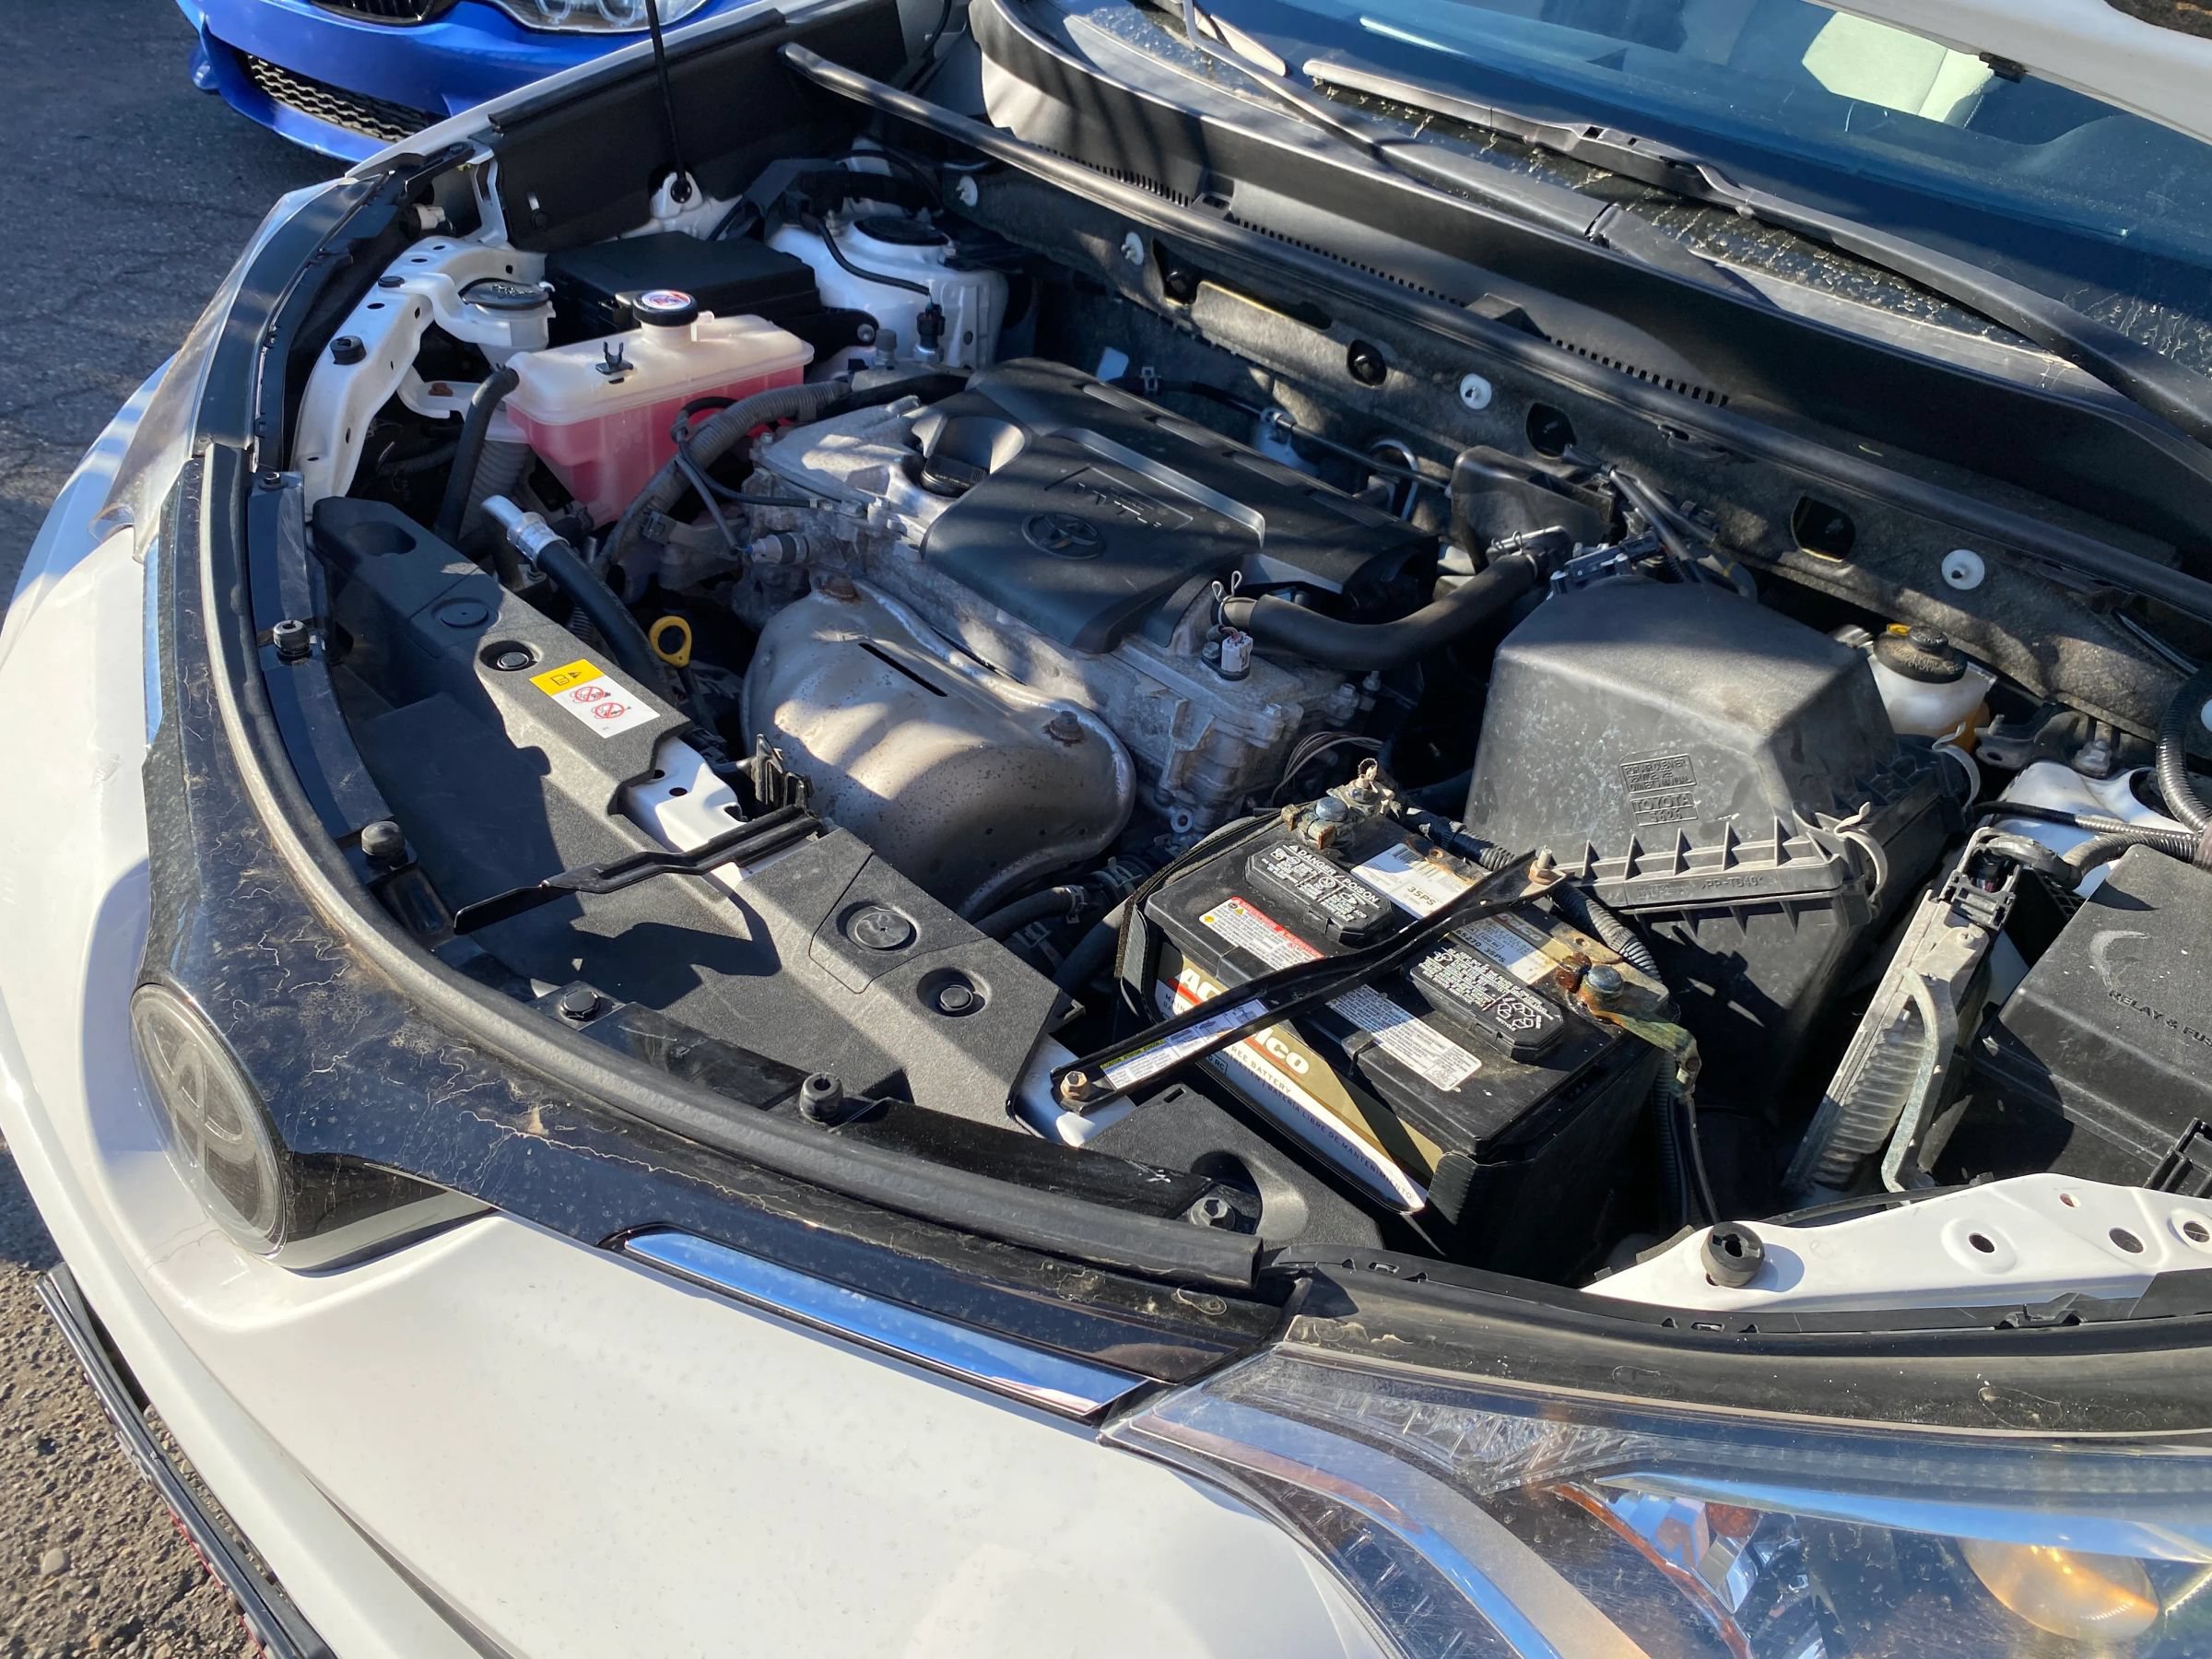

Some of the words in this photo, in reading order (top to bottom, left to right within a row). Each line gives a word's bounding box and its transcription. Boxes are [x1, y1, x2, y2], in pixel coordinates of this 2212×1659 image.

[1631, 794, 1690, 812] TOYOTA
[1297, 849, 1336, 876] DANGER
[1343, 877, 1380, 903] POISON
[1407, 885, 1437, 906] 35PS
[1484, 947, 1506, 963] 35PS
[2108, 989, 2164, 1020] RELAY
[2166, 1018, 2178, 1030] &
[1231, 1045, 1248, 1063] REE
[1250, 1061, 1291, 1094] BATTERY
[1301, 1112, 1325, 1134] LIBRE
[1329, 1131, 1341, 1144] DE
[1341, 1142, 1412, 1199] MANTENIMIENTO
